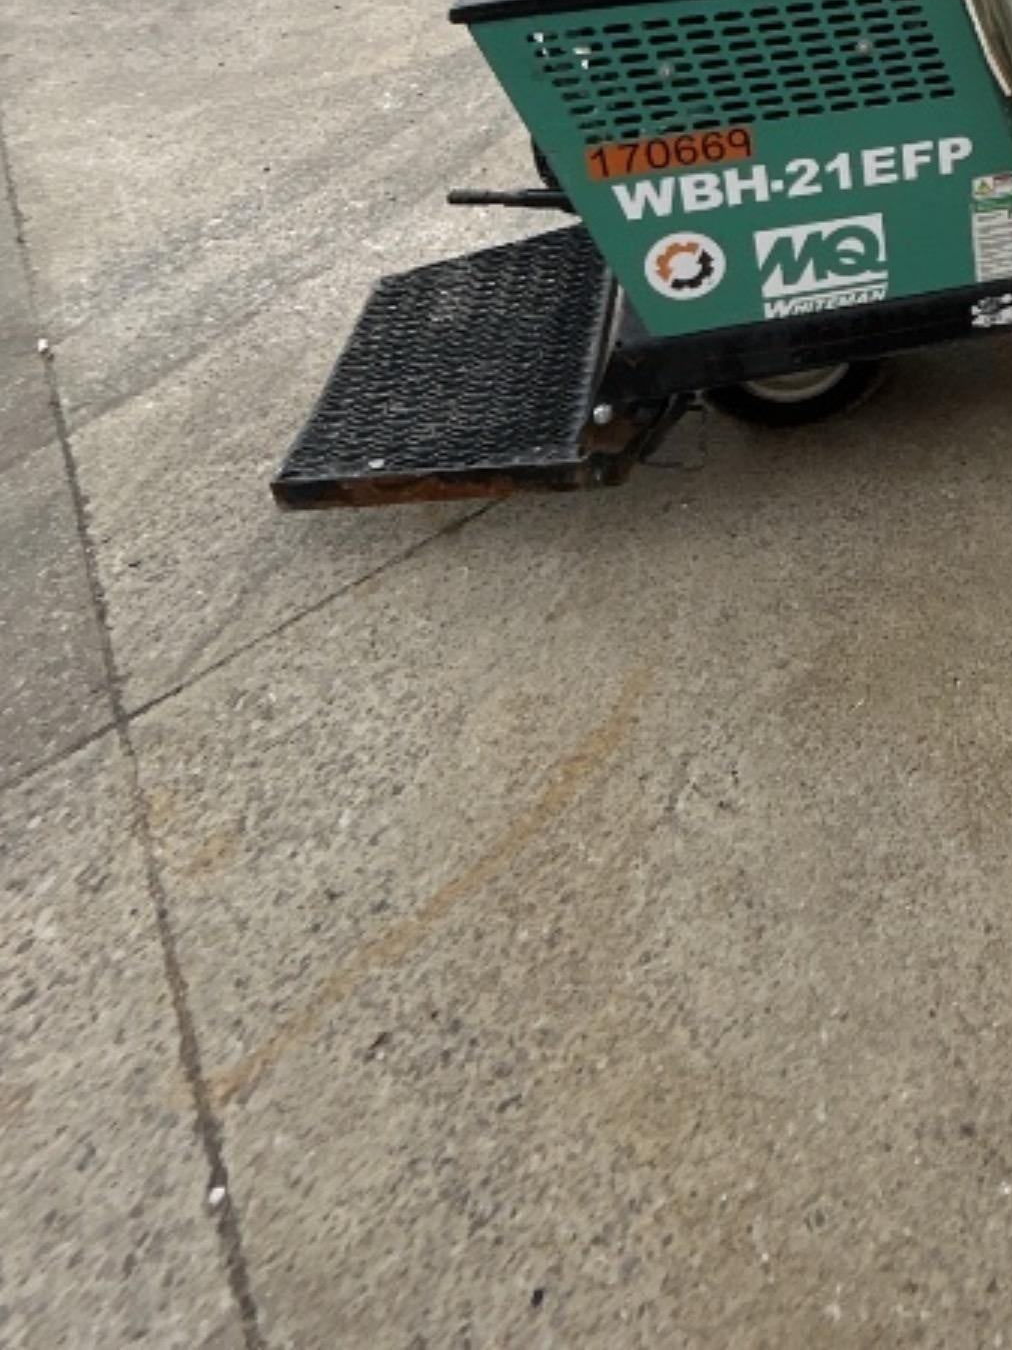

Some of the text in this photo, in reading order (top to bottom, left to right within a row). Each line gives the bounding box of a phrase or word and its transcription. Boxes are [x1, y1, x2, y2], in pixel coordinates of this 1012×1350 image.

[590, 128, 752, 178] 170669
[612, 137, 973, 221] WBH-21EFP
[756, 220, 888, 292] MQ
